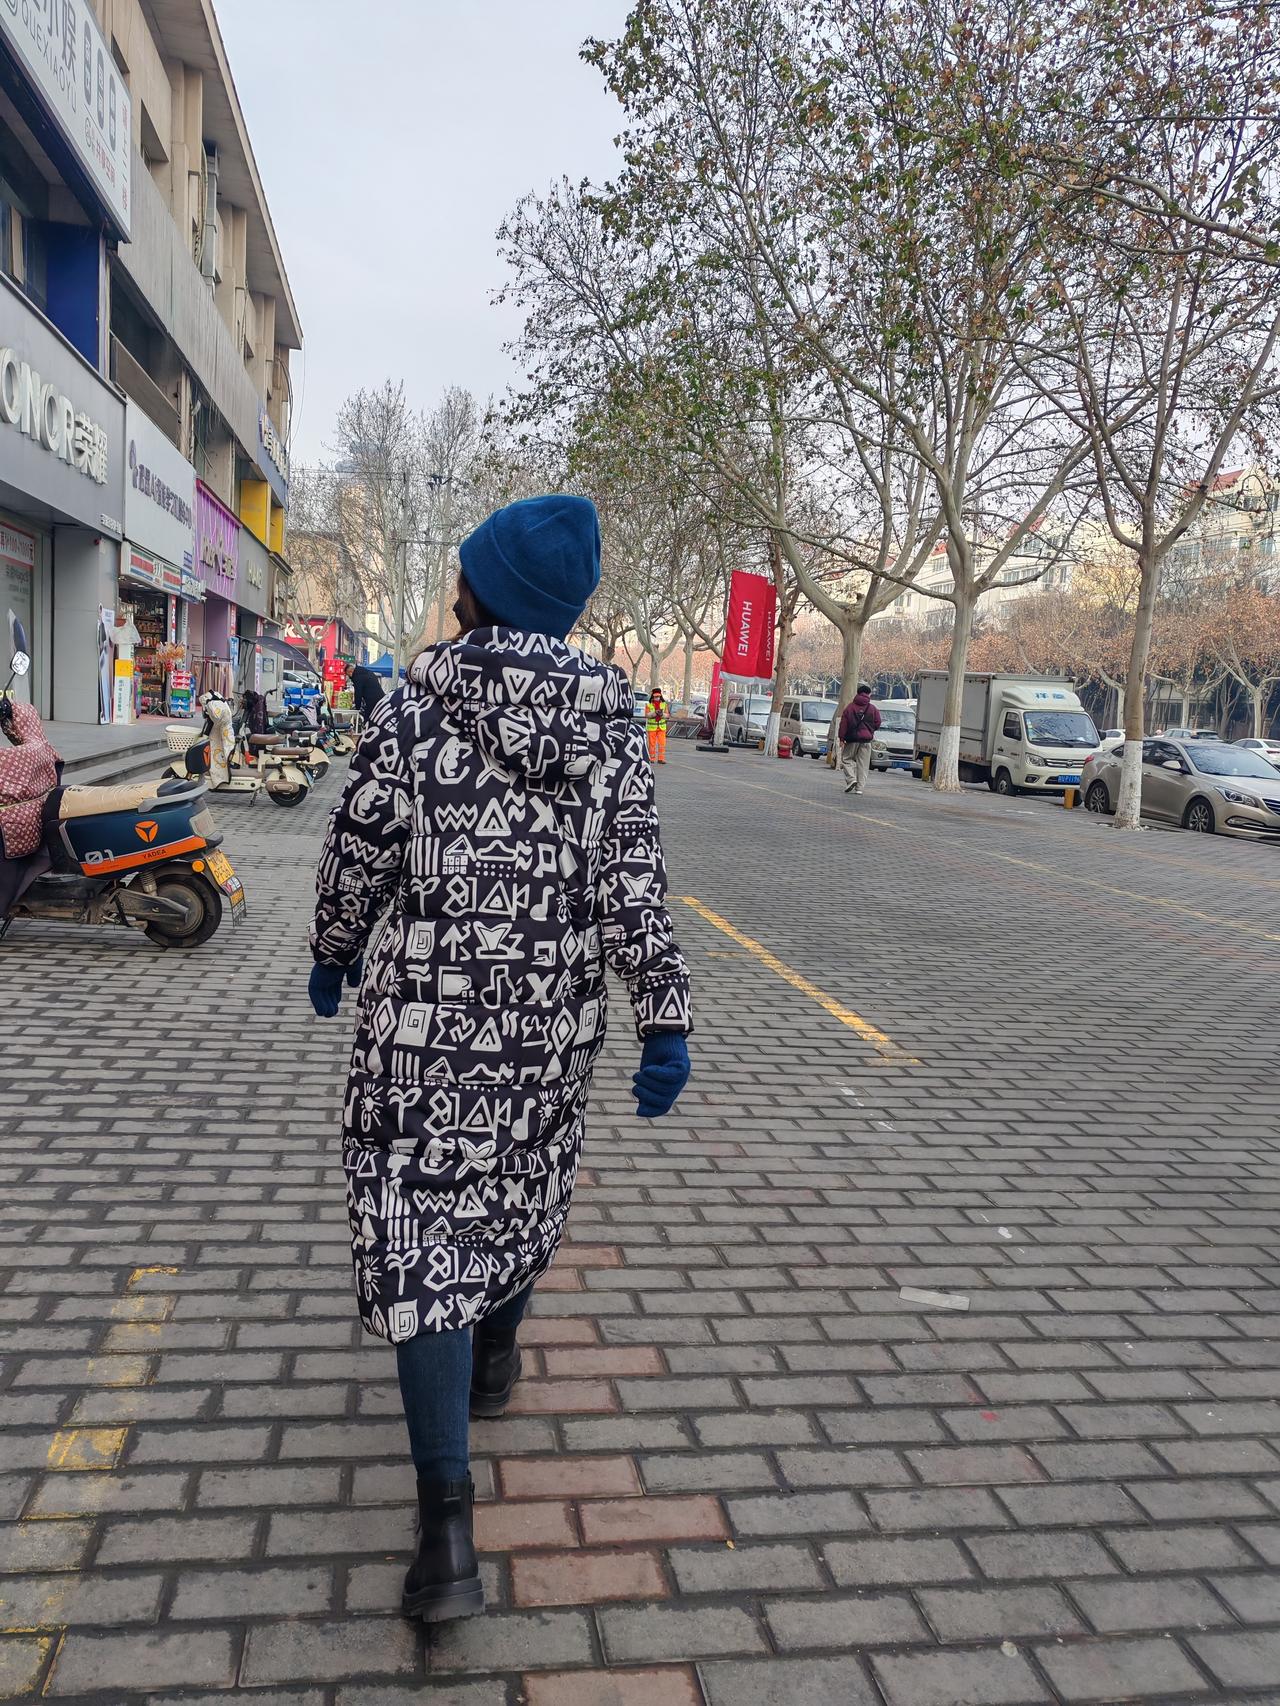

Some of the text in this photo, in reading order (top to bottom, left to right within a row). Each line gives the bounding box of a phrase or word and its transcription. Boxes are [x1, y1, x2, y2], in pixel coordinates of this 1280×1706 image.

[22, 0, 76, 113] QUEXIAOYU
[737, 600, 752, 657] HUAWEI
[85, 849, 114, 865] 01
[143, 849, 167, 859] YADEA
